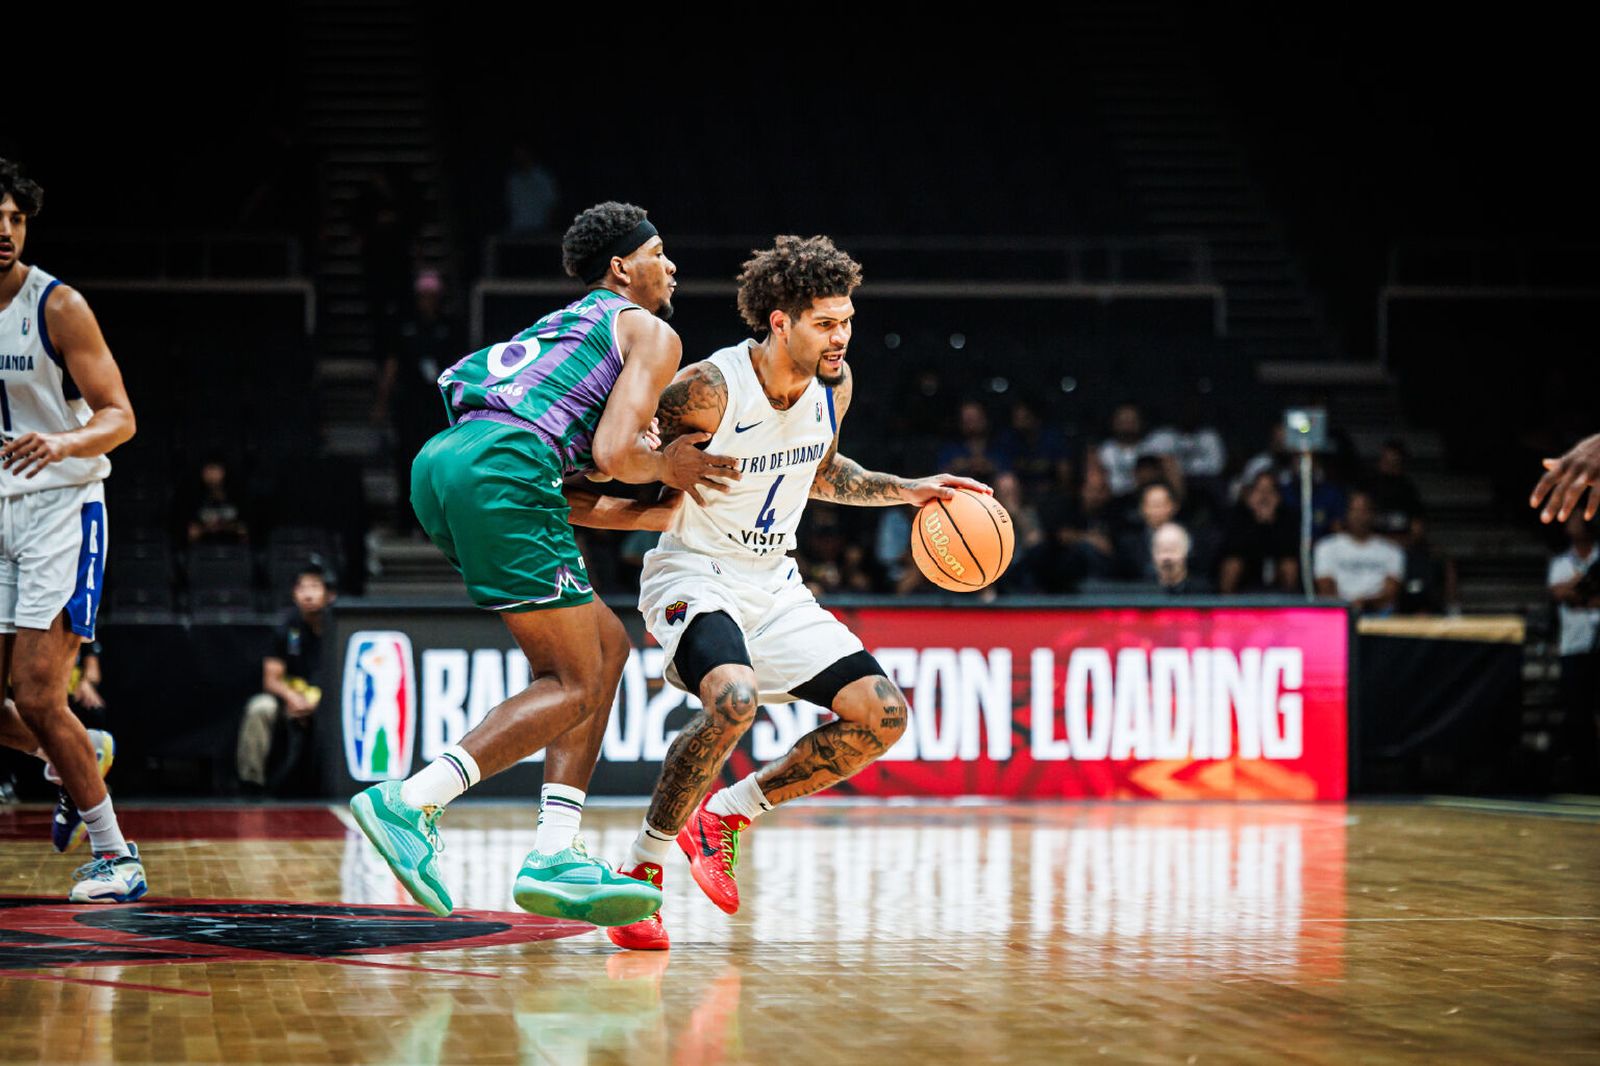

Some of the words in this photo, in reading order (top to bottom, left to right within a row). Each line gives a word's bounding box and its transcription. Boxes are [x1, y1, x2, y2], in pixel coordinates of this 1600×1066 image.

[770, 452, 784, 470] DE
[755, 474, 785, 533] 4
[741, 529, 786, 546] VISIT
[924, 511, 966, 577] Wilson
[1030, 646, 1304, 761] LOADING
